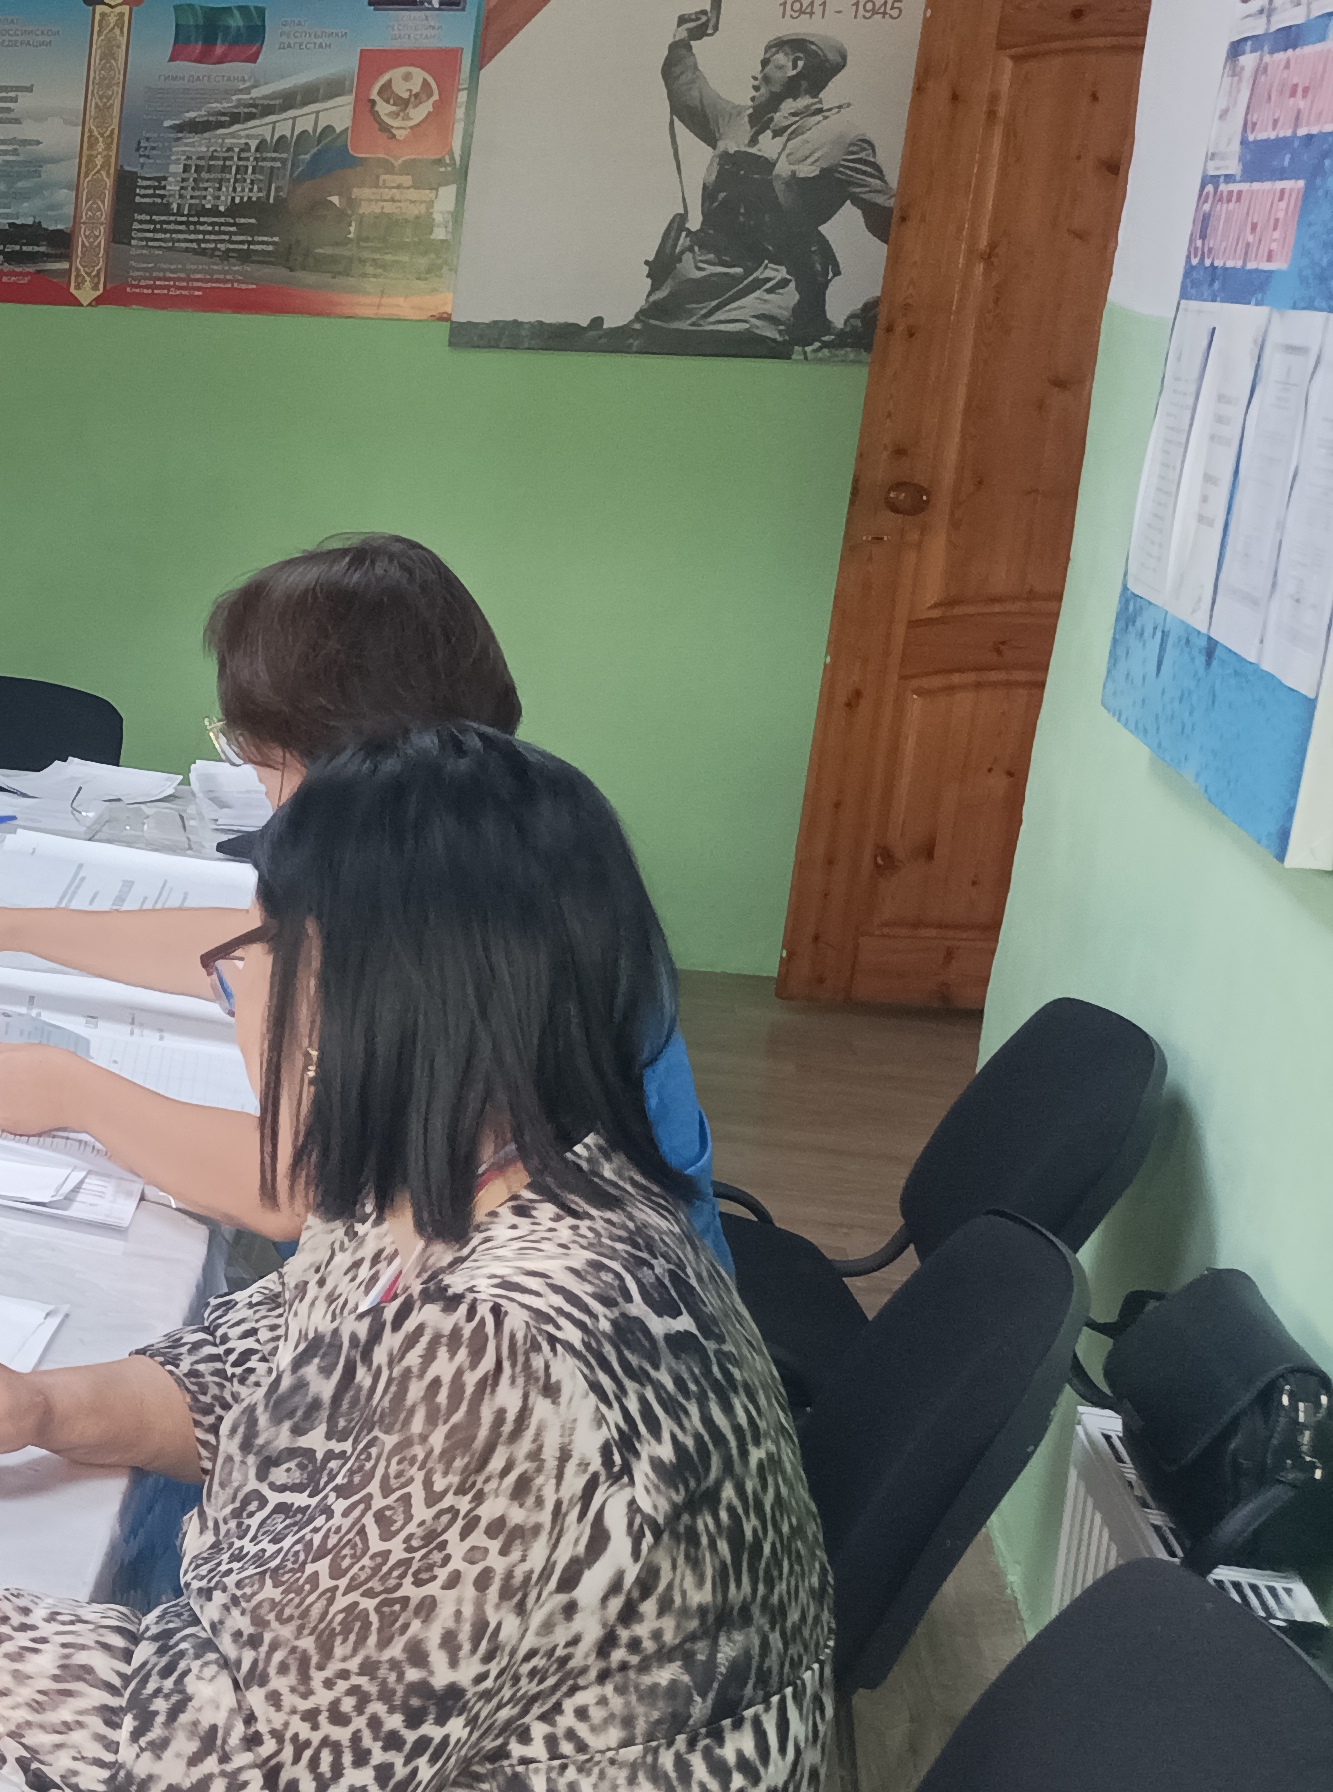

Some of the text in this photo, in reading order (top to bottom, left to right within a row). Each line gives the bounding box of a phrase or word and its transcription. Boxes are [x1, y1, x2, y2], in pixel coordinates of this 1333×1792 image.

[778, 0, 827, 20] 1941
[850, 0, 904, 20] 1945
[280, 19, 308, 28] ФЛАГ
[279, 30, 348, 40] РЕСПУБЛИКИ
[277, 41, 332, 51] ДАГЕСТАН
[158, 74, 247, 84] ГИМН ДАГЕСТАНА
